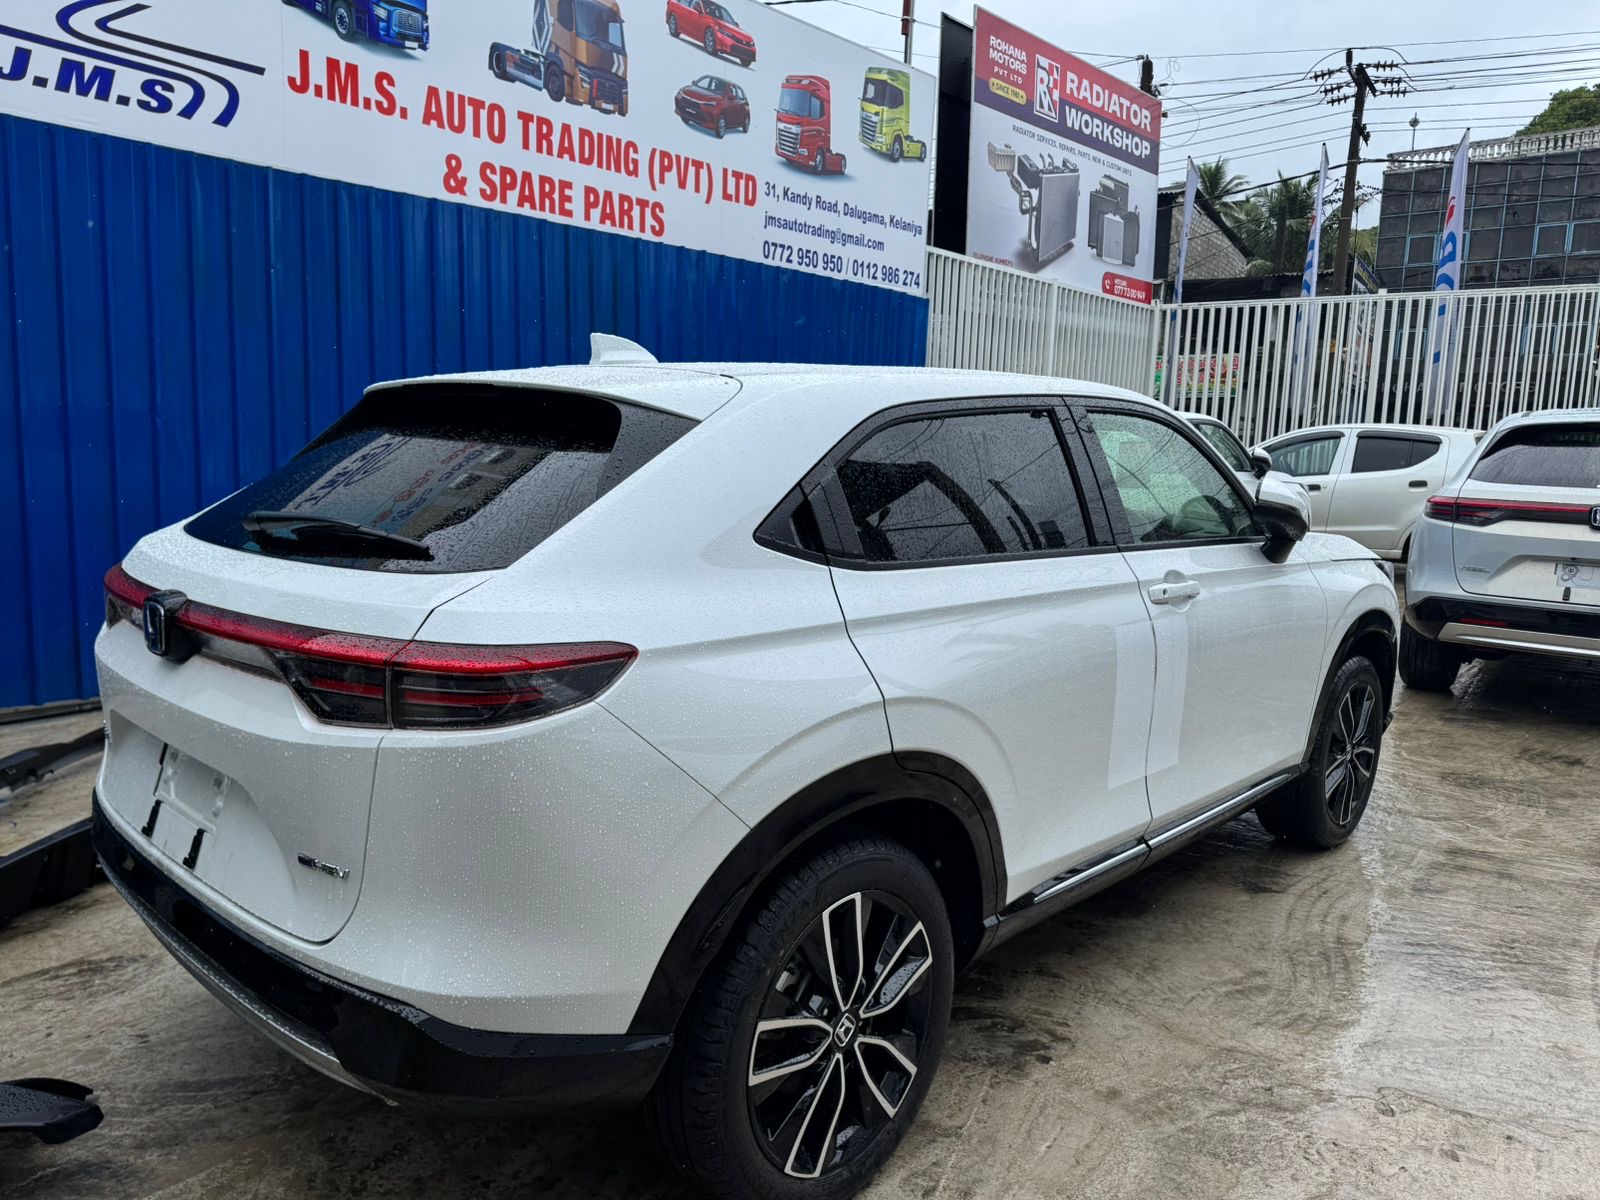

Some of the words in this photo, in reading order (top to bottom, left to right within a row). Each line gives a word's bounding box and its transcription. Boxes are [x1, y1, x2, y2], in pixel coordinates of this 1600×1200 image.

[989, 35, 1027, 63] ROHANA
[989, 48, 1027, 75] MOTORS
[0, 46, 175, 114] J.M.S
[994, 65, 1008, 78] PVT
[1010, 73, 1023, 85] LTD
[995, 82, 1010, 96] SINCE
[1066, 70, 1151, 132] RADIATOR
[287, 48, 408, 120] J.M.S.
[422, 85, 506, 144] AUTO
[517, 110, 640, 178] TRADING
[648, 147, 714, 204] (PVT)
[722, 167, 758, 207] LTD
[1012, 124, 1036, 140] RADIATOR
[1036, 134, 1057, 149] SERVICES,
[1058, 142, 1077, 156] REPAIRS,
[1077, 150, 1092, 162] PARTS,
[1106, 161, 1122, 173] CUSTOM
[1065, 105, 1151, 159] WORKSHOP
[443, 153, 468, 197] &
[479, 161, 574, 219] SPARE
[584, 185, 665, 238] PARTS
[764, 181, 780, 203] 31,
[783, 186, 813, 211] Kandy
[815, 195, 841, 218] Road,
[843, 202, 888, 229] Dalugama,
[889, 214, 923, 237] Kelaniya
[764, 211, 885, 251] jmsautotrading@gmail.com
[762, 240, 793, 264] 0772
[797, 247, 819, 269] 950
[822, 252, 843, 274] 950
[852, 259, 878, 281] 0112
[881, 264, 900, 285] 986
[902, 269, 920, 289] 274
